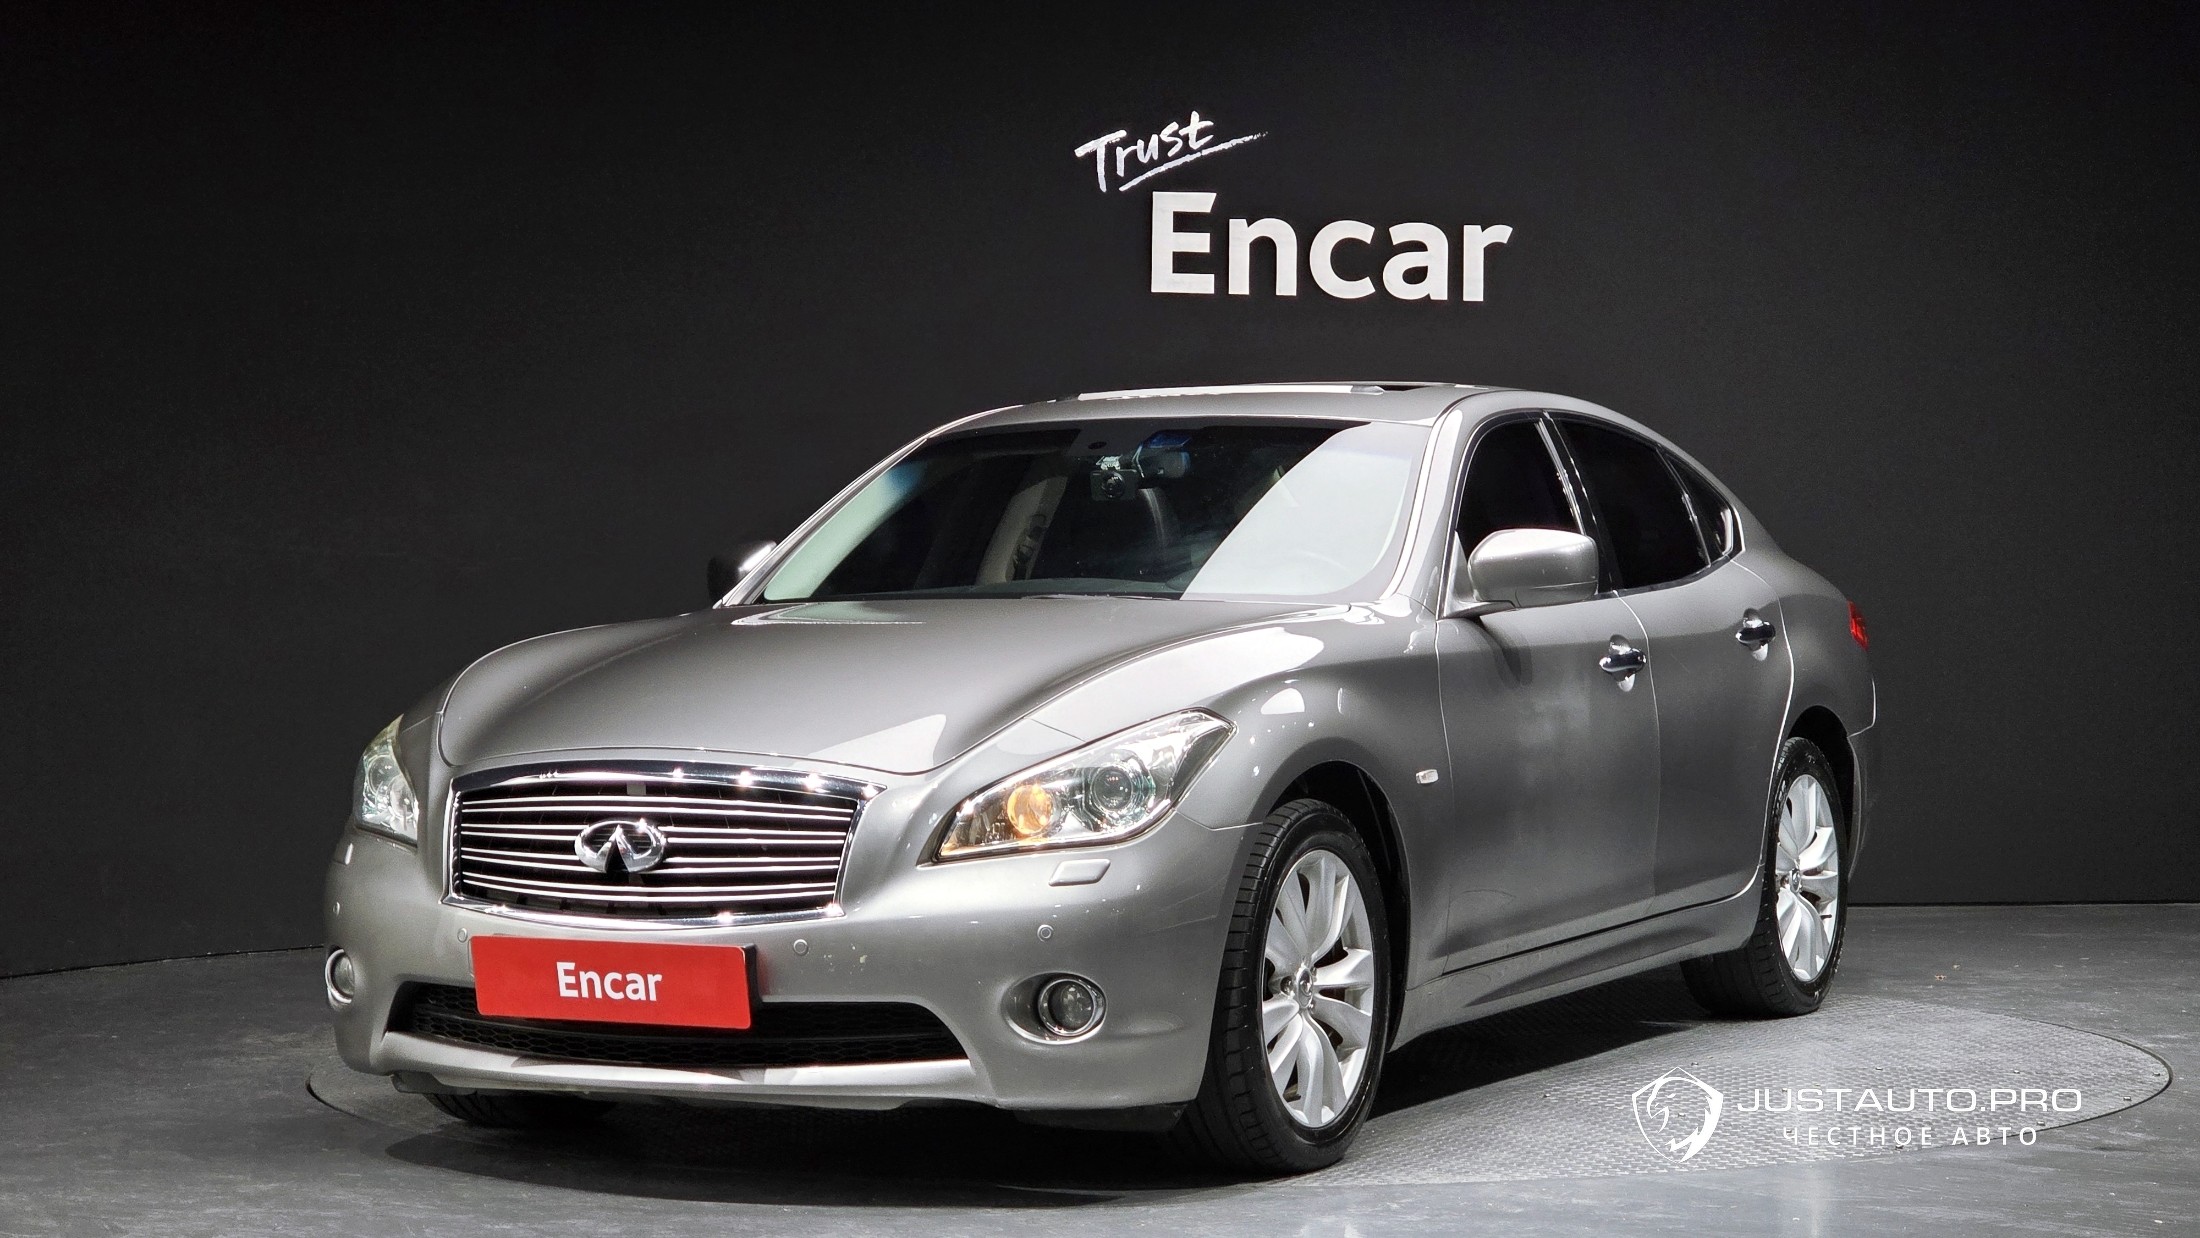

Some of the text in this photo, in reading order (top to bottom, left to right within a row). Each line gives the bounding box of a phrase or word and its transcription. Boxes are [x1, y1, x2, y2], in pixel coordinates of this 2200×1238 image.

[1074, 110, 1215, 193] Trust
[1150, 190, 1514, 302] Encar
[556, 961, 663, 1001] Encar
